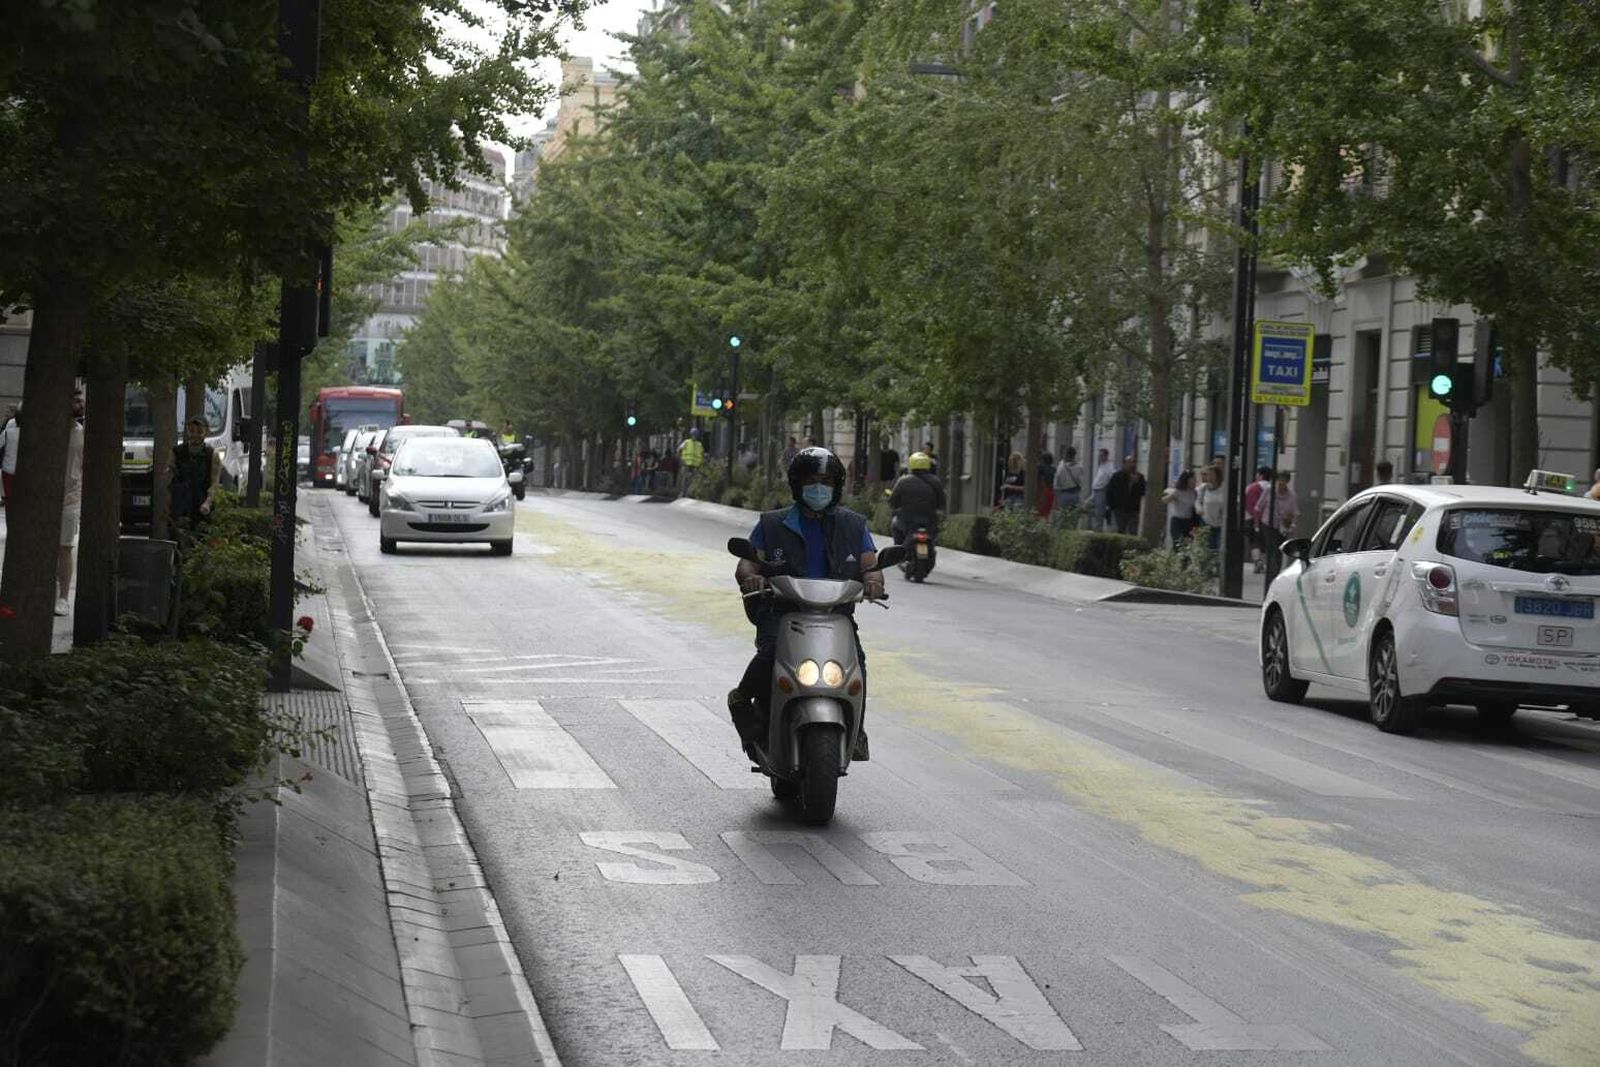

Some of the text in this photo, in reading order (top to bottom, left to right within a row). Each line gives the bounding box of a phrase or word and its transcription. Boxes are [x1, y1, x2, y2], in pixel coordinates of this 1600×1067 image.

[1267, 364, 1298, 377] TAXI
[1543, 628, 1568, 644] SP
[577, 830, 1032, 887] BUS
[617, 953, 1338, 1051] TAXI
